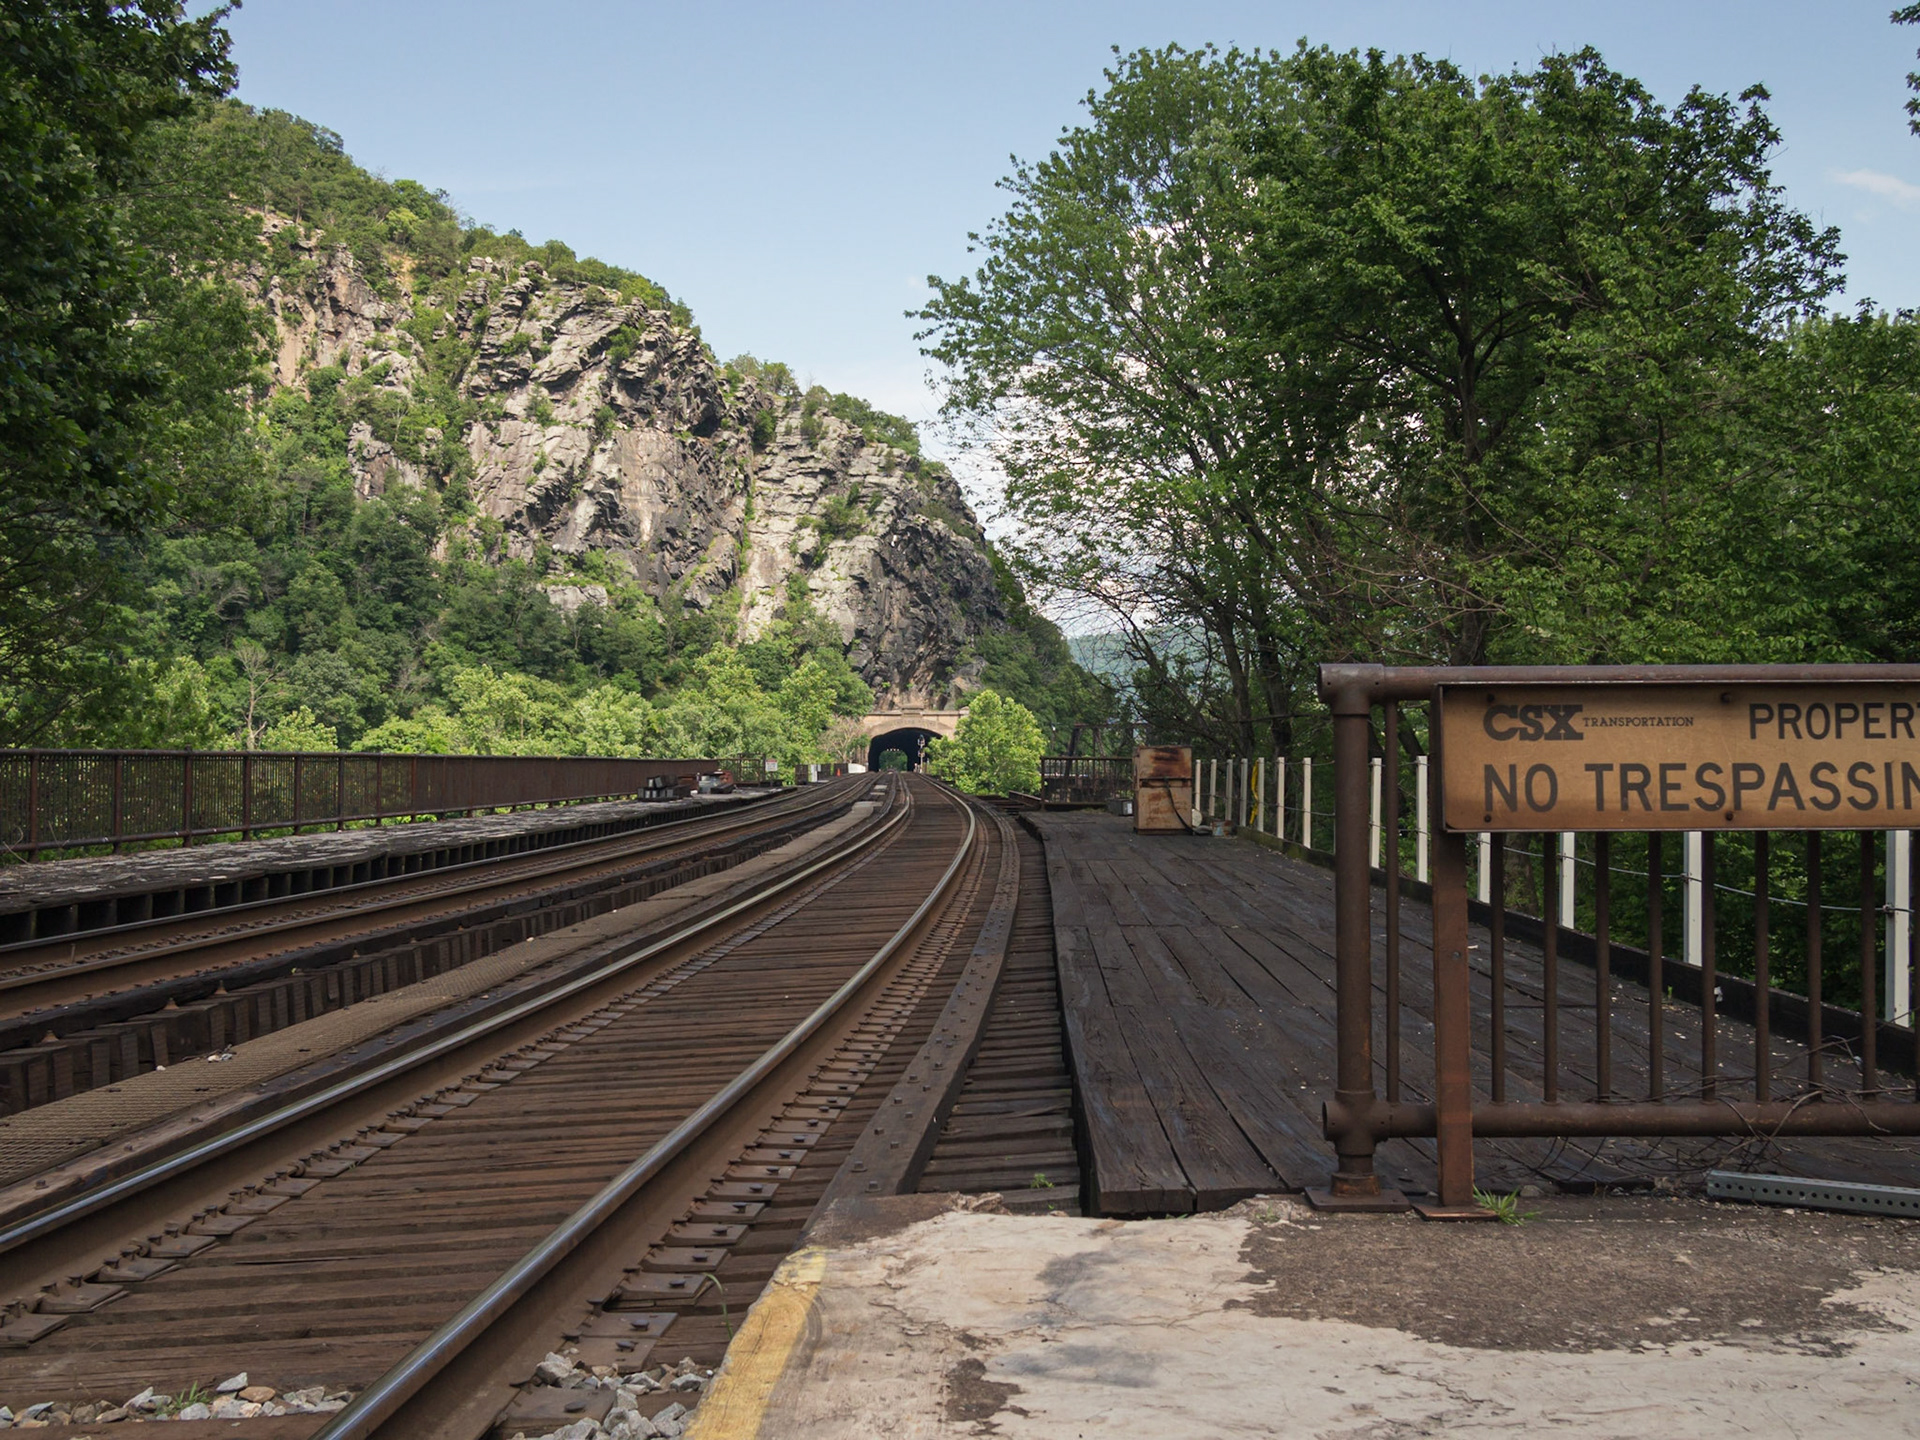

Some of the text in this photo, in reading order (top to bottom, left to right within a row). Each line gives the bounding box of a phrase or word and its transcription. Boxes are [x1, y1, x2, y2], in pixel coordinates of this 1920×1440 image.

[1483, 702, 1920, 741] CSX TRANSPORTATION PROPER
[1484, 763, 1558, 812] NO
